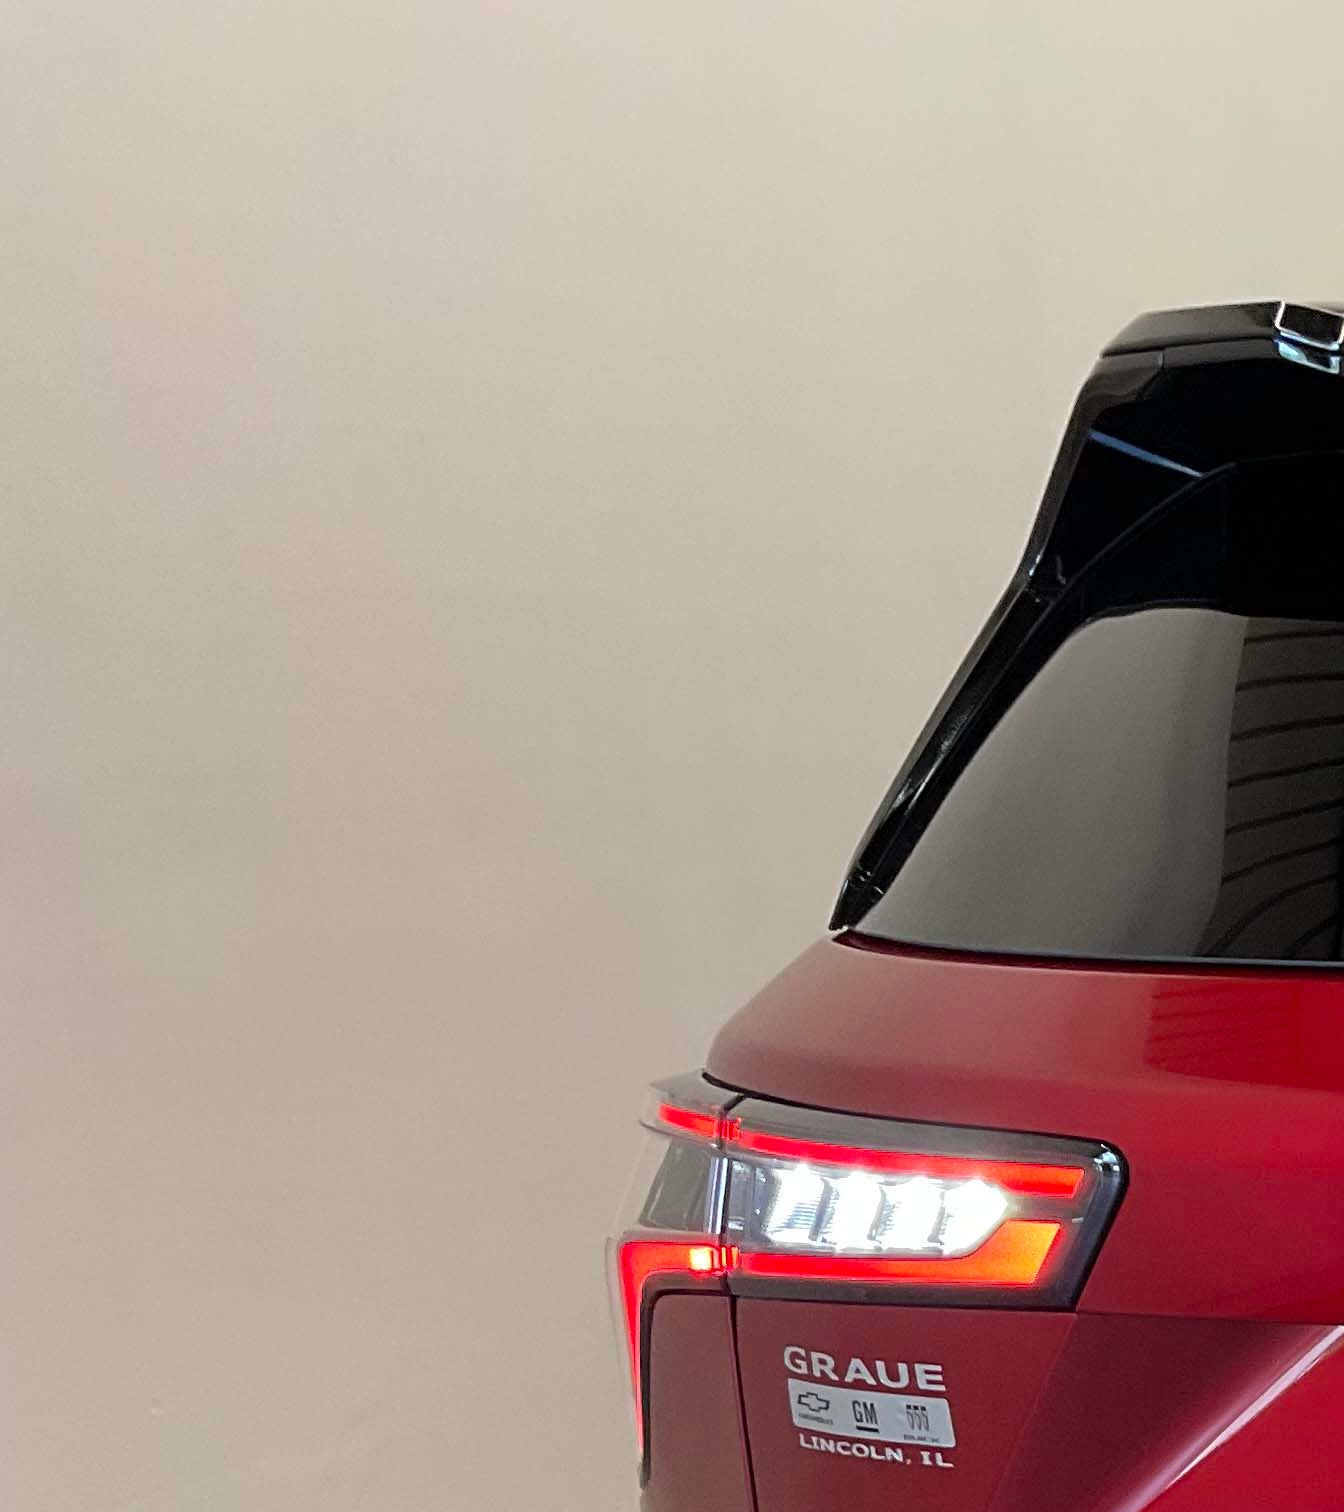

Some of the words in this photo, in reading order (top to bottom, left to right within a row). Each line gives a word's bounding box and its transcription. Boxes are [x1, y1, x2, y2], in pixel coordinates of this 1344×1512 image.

[784, 1346, 947, 1392] GRAUE
[852, 1400, 879, 1425] GM
[799, 1433, 911, 1465] LINCOLN,
[919, 1450, 954, 1468] IL
